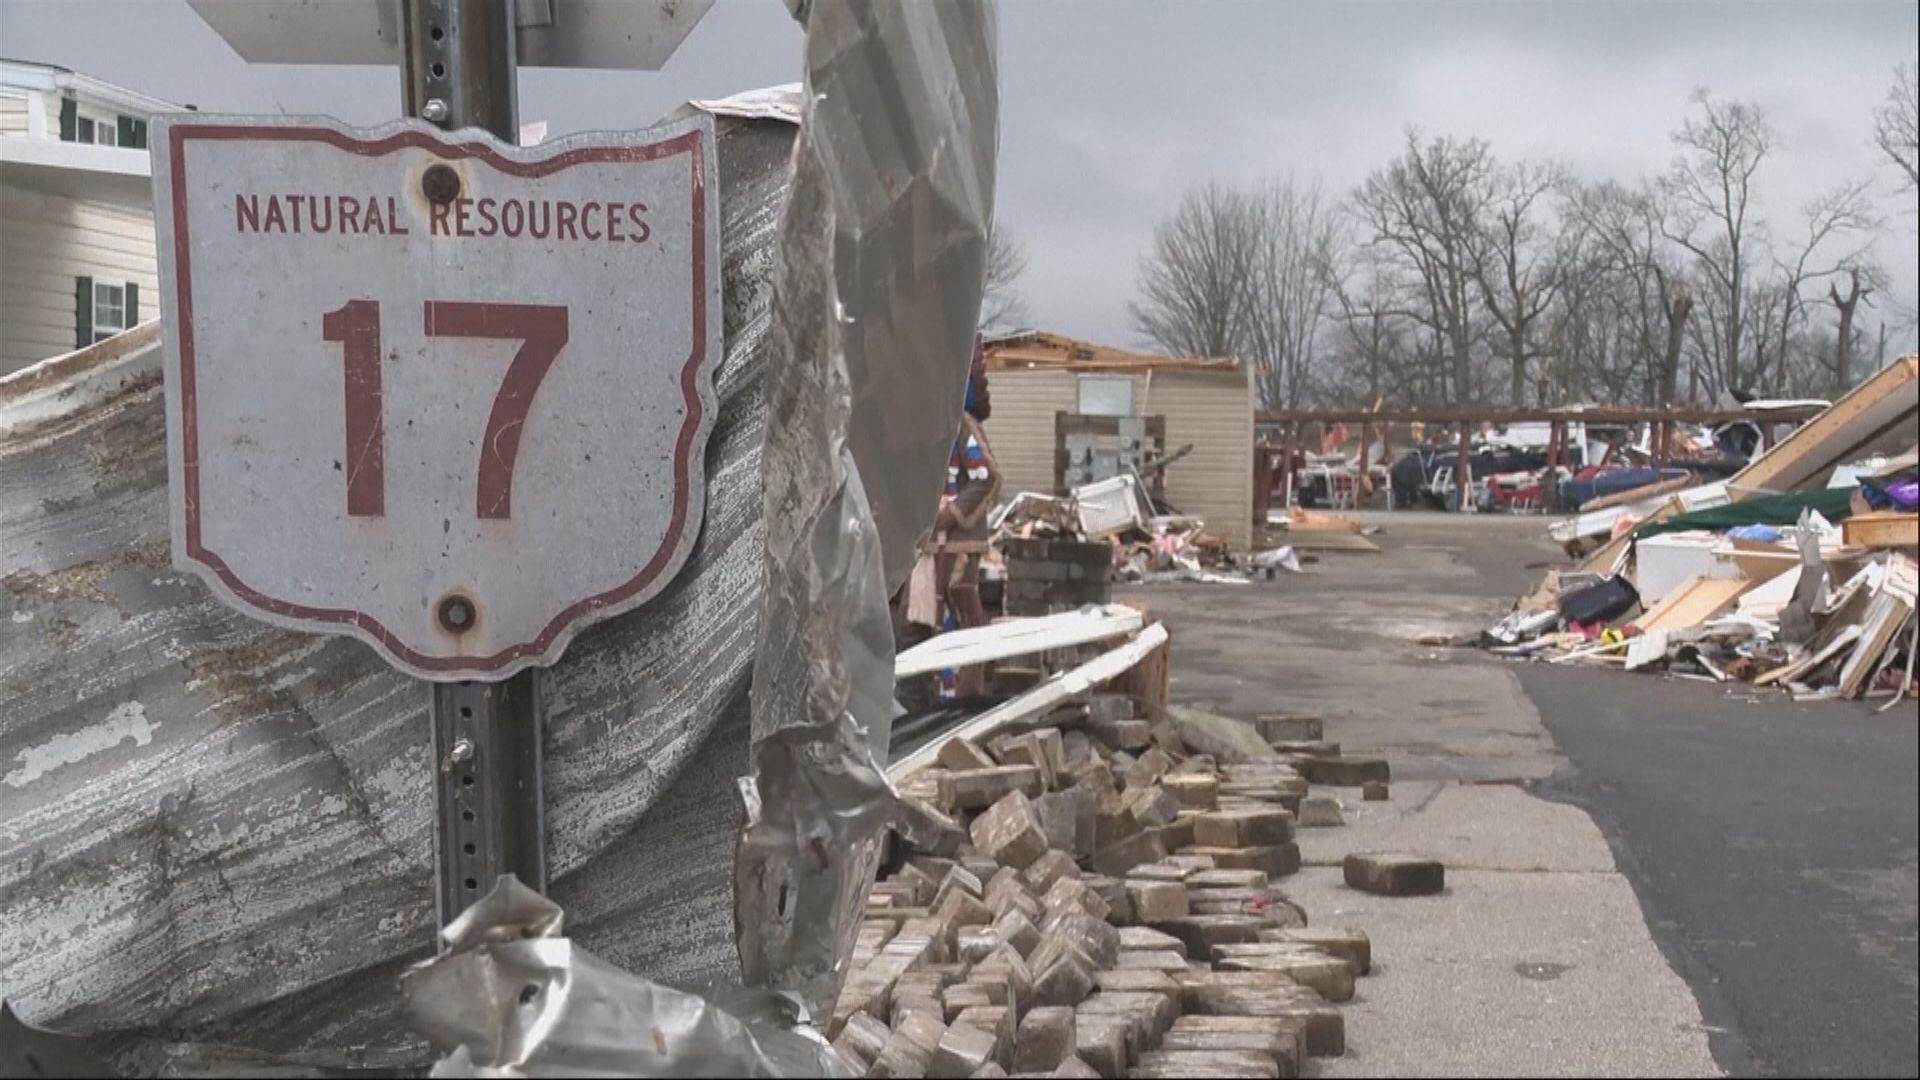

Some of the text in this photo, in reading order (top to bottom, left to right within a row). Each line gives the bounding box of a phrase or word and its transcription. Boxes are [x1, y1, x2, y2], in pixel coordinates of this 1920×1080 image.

[235, 194, 650, 243] NATURAL RESOURCES
[322, 300, 569, 519] 17
